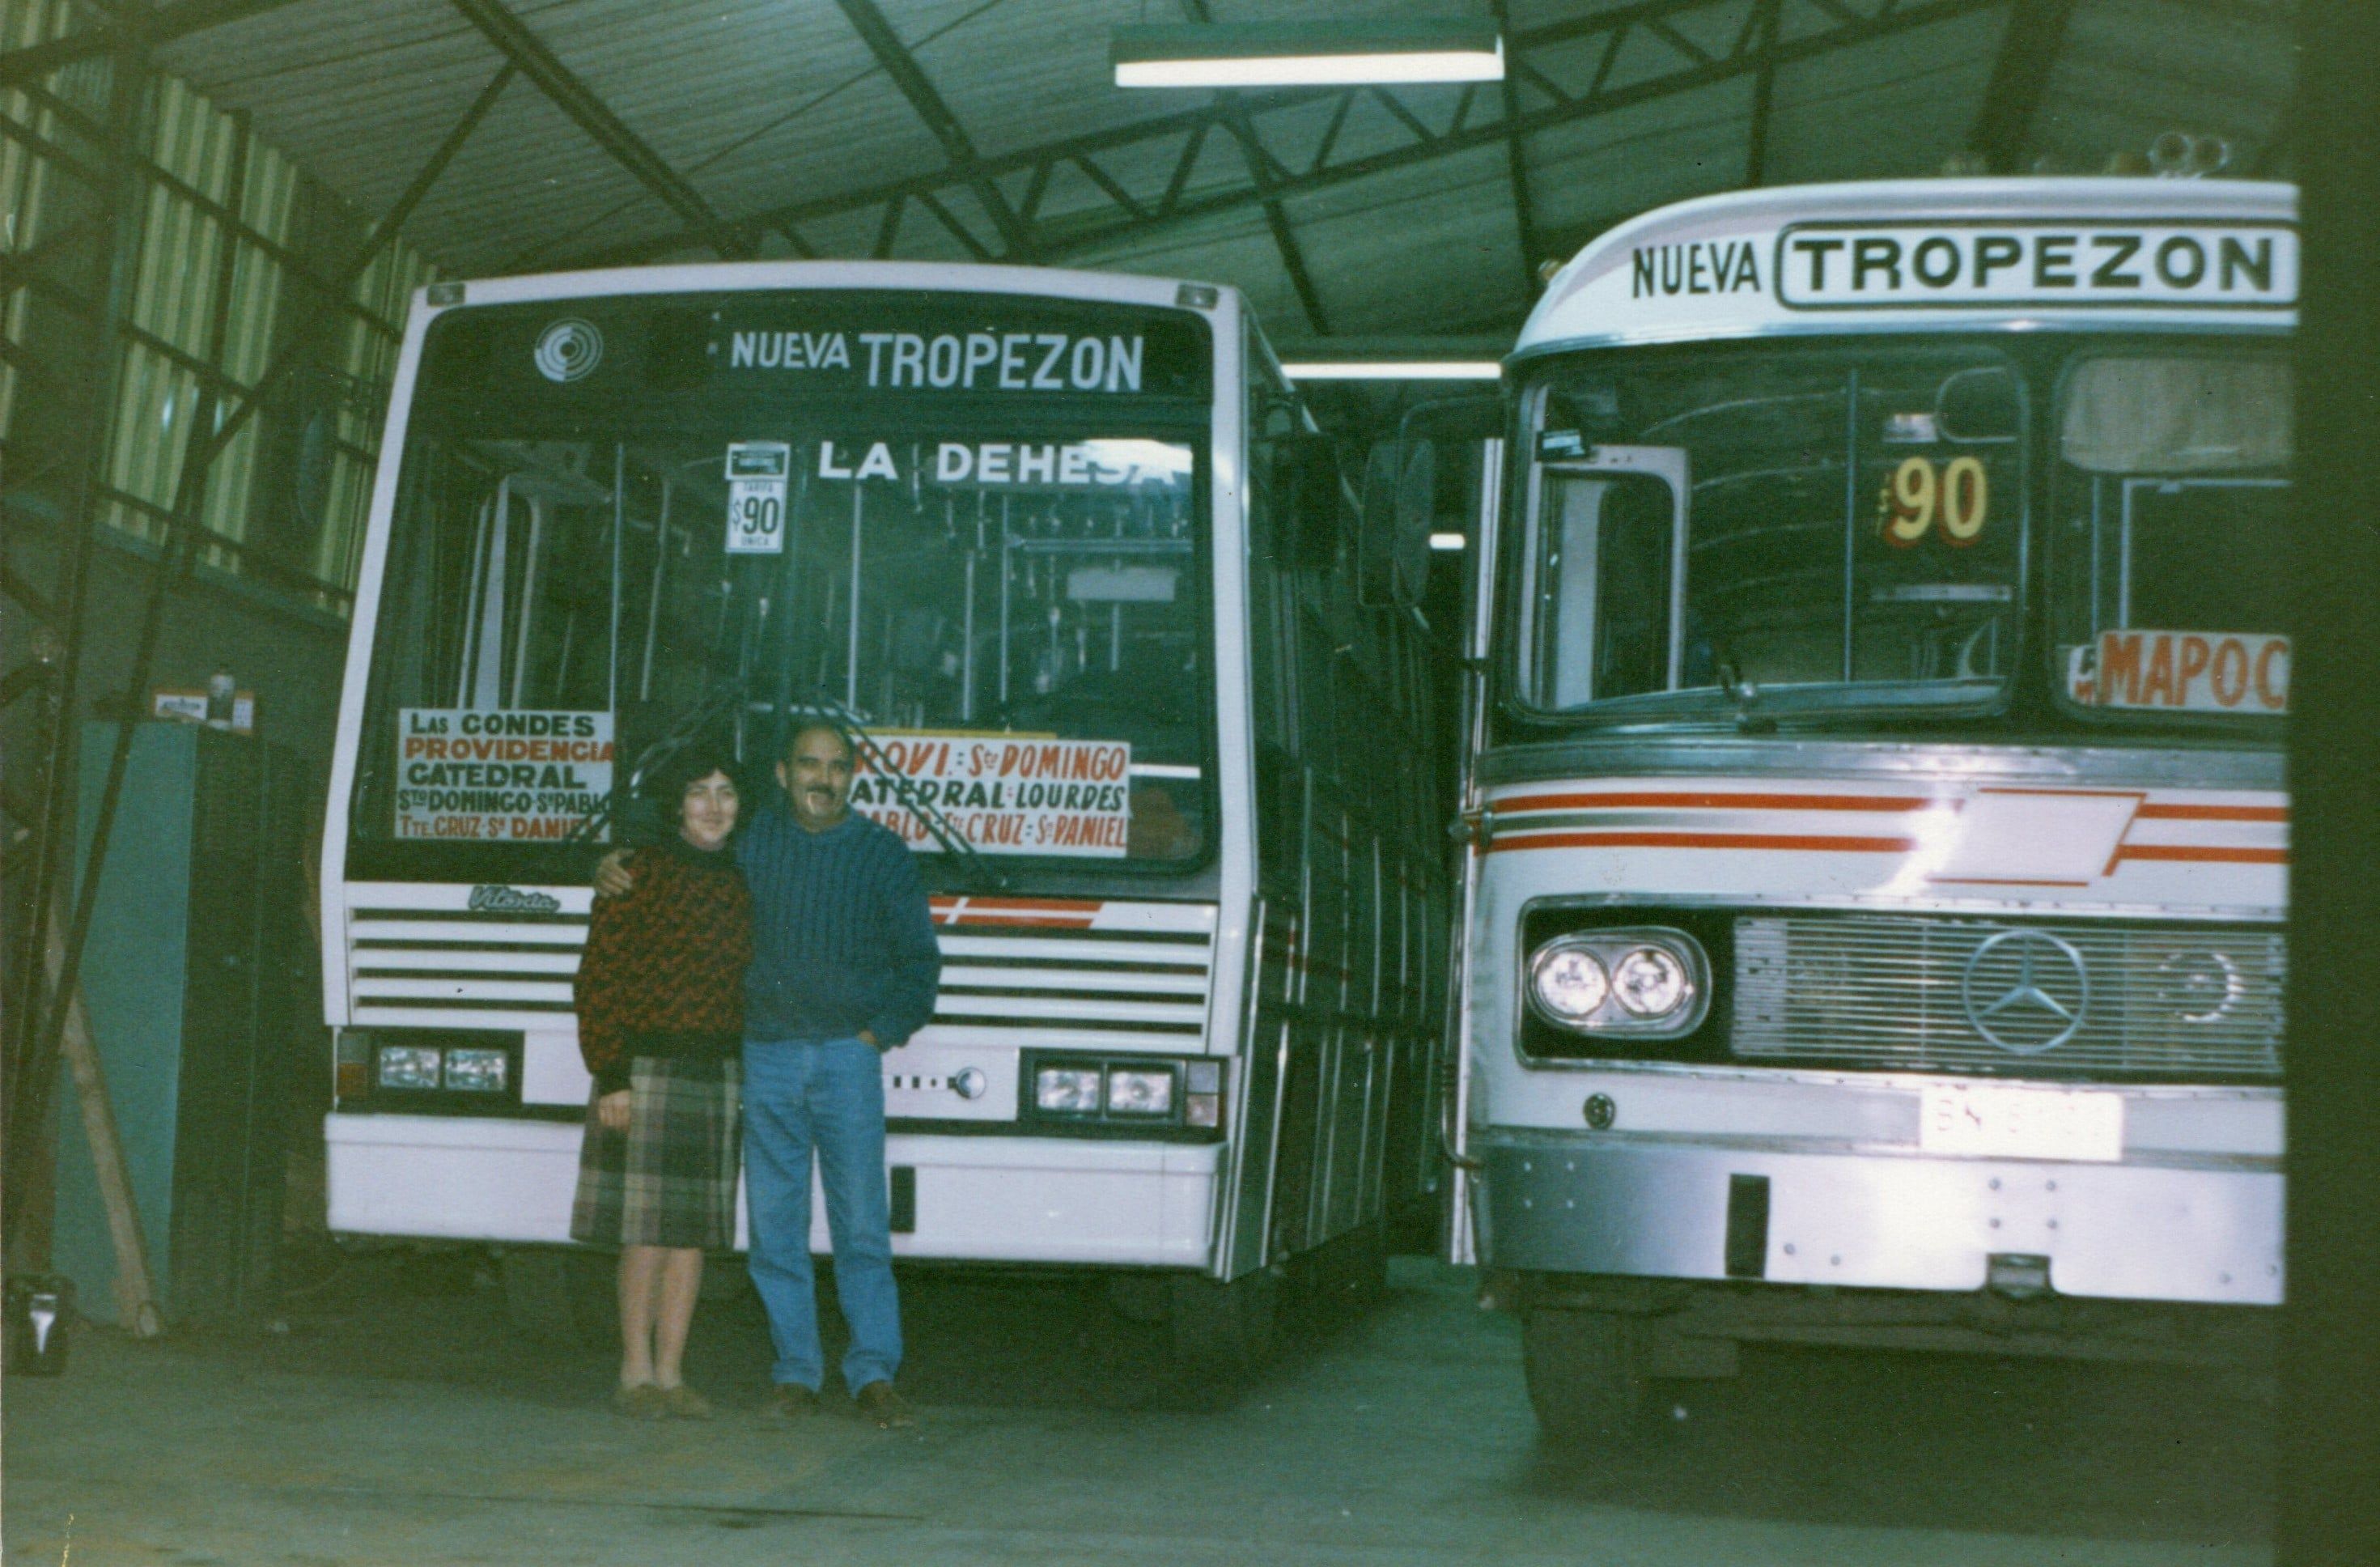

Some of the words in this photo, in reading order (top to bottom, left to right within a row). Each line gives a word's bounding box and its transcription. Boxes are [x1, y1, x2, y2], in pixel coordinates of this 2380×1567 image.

[1631, 240, 1761, 299] NUEVA
[1792, 236, 2276, 292] TROPEZON
[731, 330, 851, 369] NUEVA
[859, 332, 1144, 392] TROPEZON
[818, 440, 898, 482] LA
[732, 495, 780, 535] $90
[461, 713, 596, 737] CONDES
[405, 737, 613, 762] PROVIDENCIA
[998, 744, 1126, 781] DOMINGO
[406, 762, 588, 789] CATEDRAL
[428, 791, 532, 813] DOMINGO
[851, 778, 1005, 809] ATEDRAL
[1015, 781, 1126, 812] LOURDES
[434, 816, 481, 838] CRUZ
[965, 812, 1026, 845] CRUZ
[1053, 814, 1126, 847] DANIEL
